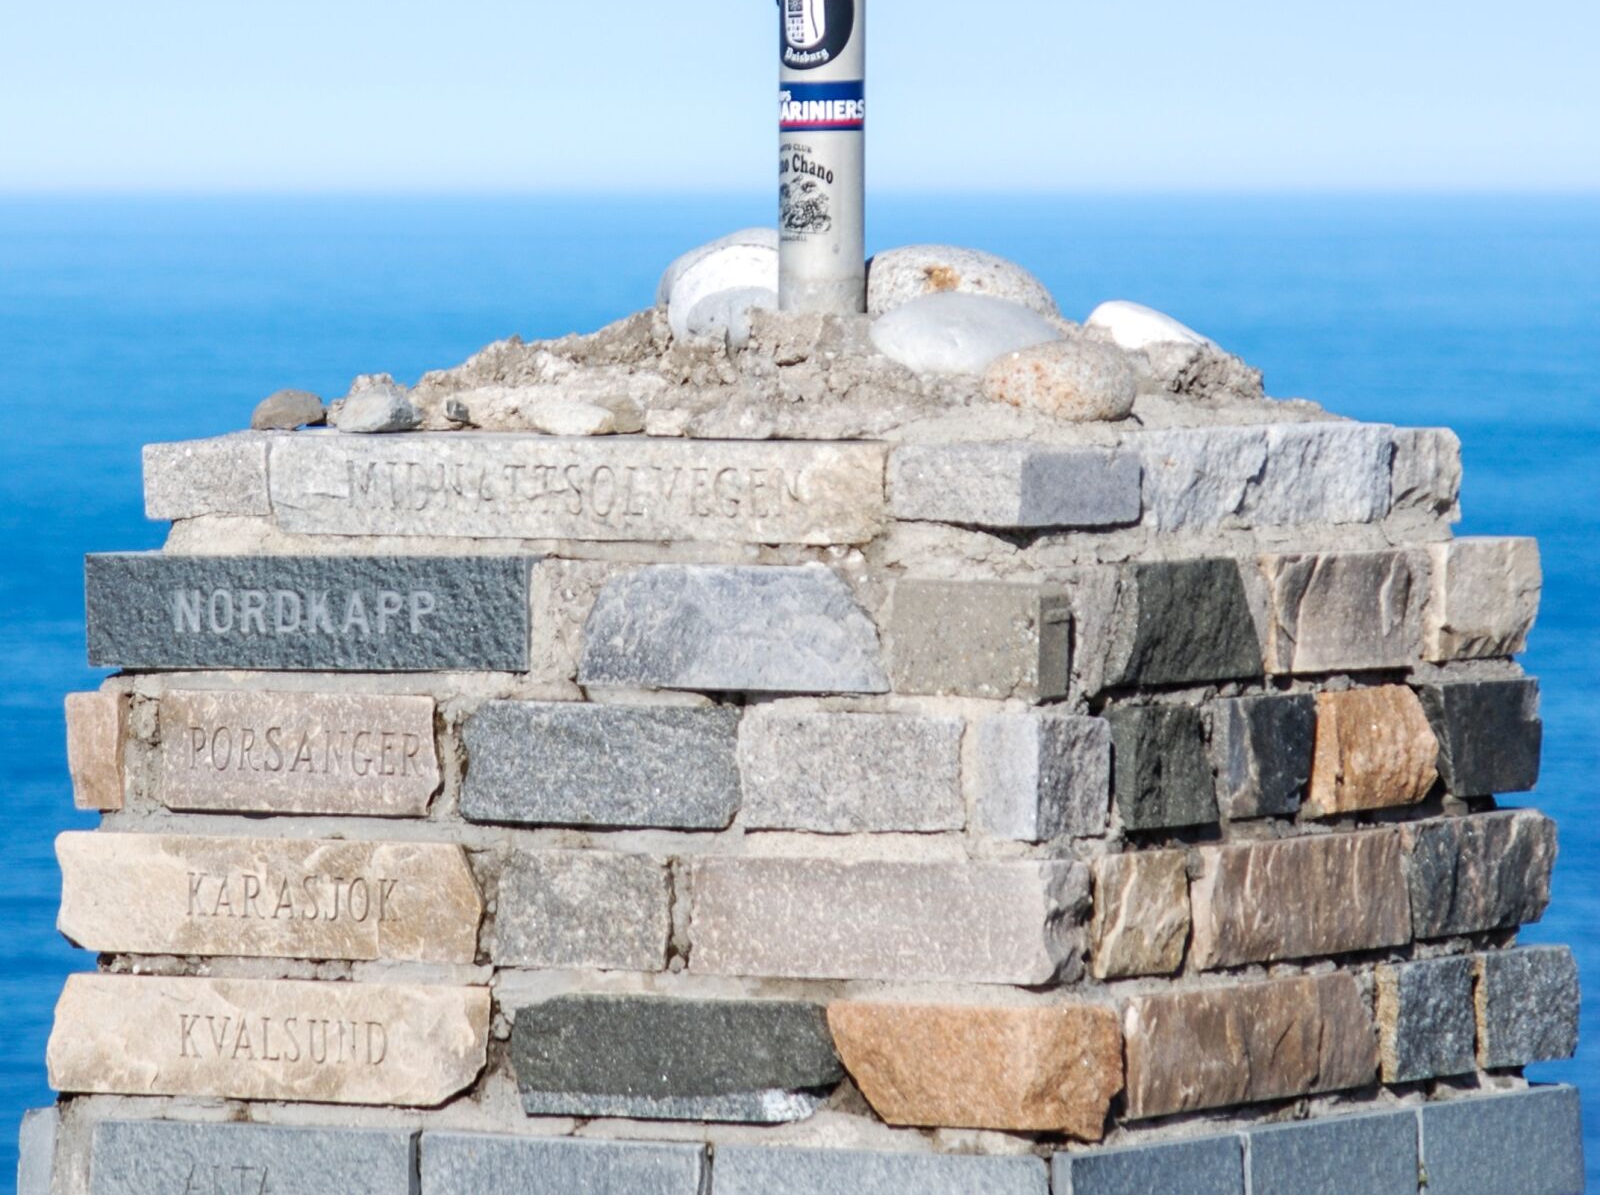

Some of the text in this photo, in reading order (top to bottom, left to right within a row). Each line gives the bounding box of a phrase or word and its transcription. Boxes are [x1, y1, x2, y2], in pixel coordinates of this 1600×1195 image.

[779, 99, 865, 120] ARINIERS
[792, 153, 834, 184] Chano
[346, 459, 802, 520] MIDNATTSOLVEGEN
[172, 588, 437, 634] NORDKAPP
[189, 725, 423, 778] PORSANGER
[186, 871, 402, 923] KARASJOK
[178, 1013, 389, 1066] KVALSUND
